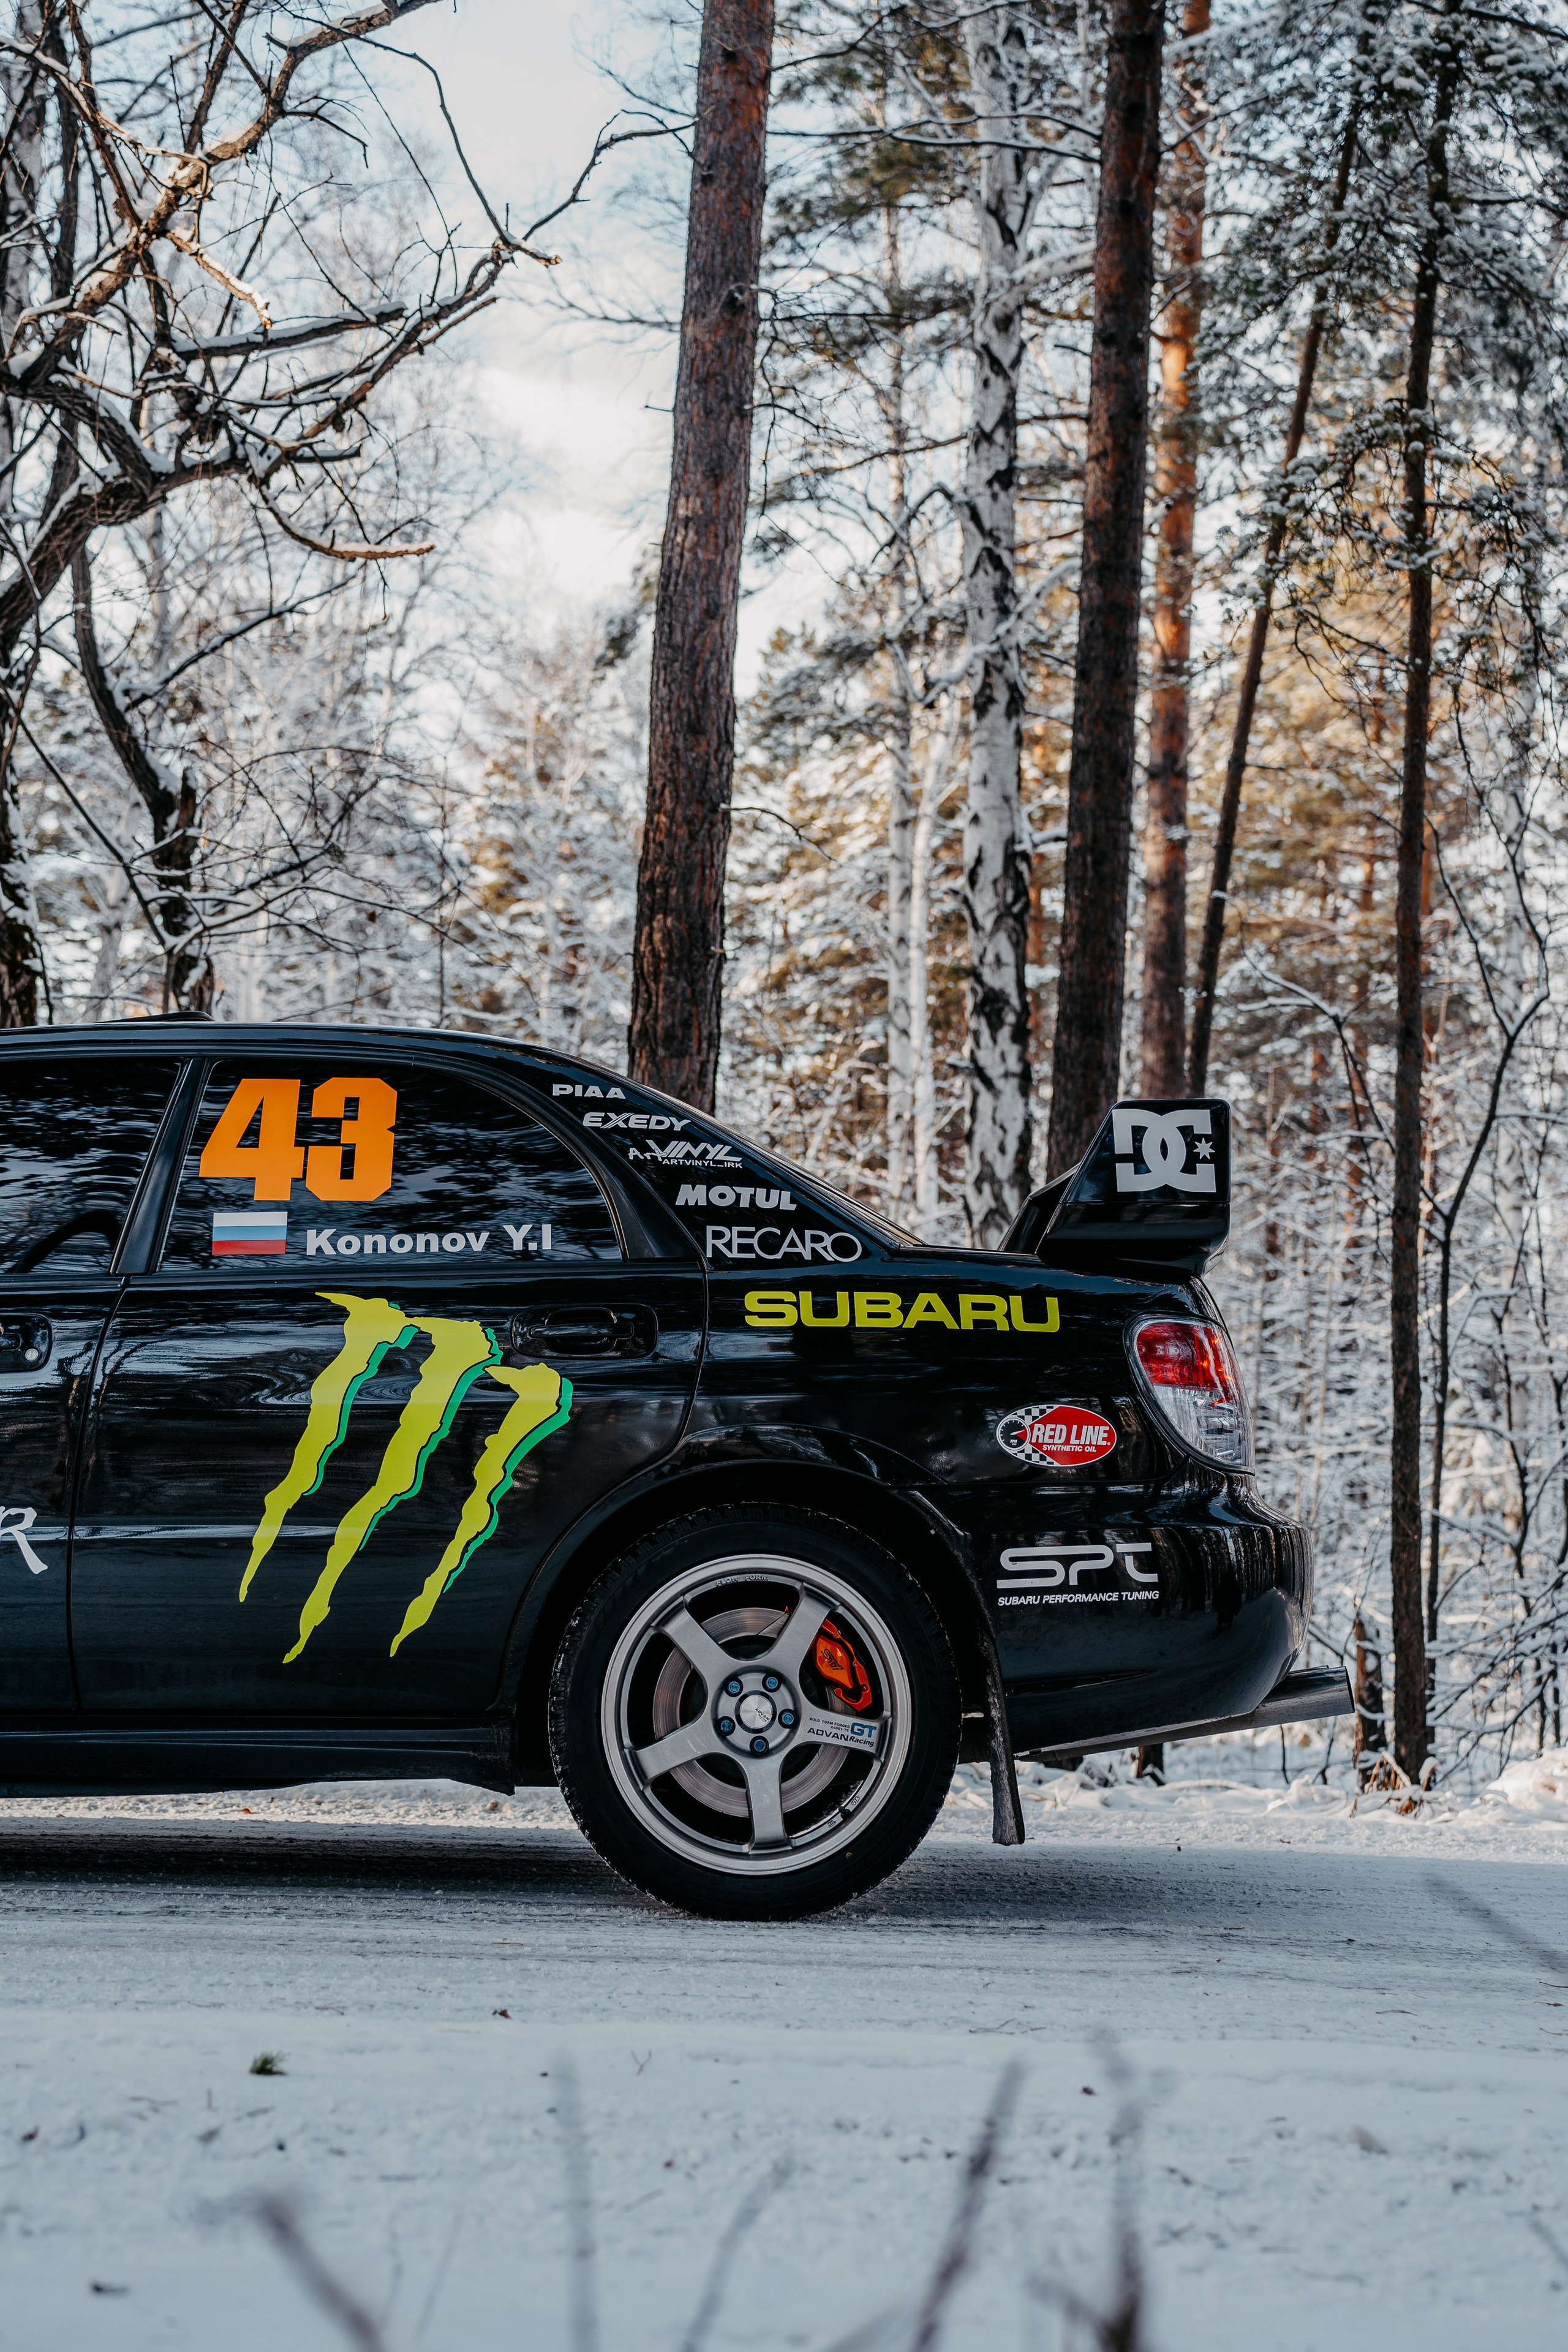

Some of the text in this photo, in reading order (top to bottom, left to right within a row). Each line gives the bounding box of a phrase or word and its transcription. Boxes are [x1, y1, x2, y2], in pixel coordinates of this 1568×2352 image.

[552, 1084, 626, 1099] PIAA
[582, 1112, 692, 1131] EXEDY
[199, 1077, 398, 1201] 43
[1112, 1109, 1216, 1193] DC
[662, 1158, 743, 1169] ARTVINYL_IRK
[675, 1184, 797, 1210] MOTUL
[306, 1224, 552, 1256] Kononov Y.I
[706, 1225, 862, 1262] RECARO
[744, 1291, 1060, 1333] SUBARU
[1031, 1423, 1109, 1446] RED LINE
[1042, 1444, 1083, 1452] SYNTHETIC
[996, 1542, 1159, 1589] SPT
[716, 1575, 740, 1586] FLOW
[998, 1590, 1159, 1607] SUBARU PERFORMANCE TUNING
[807, 1727, 875, 1747] ADVAN Racing
[850, 1722, 877, 1738] GT
